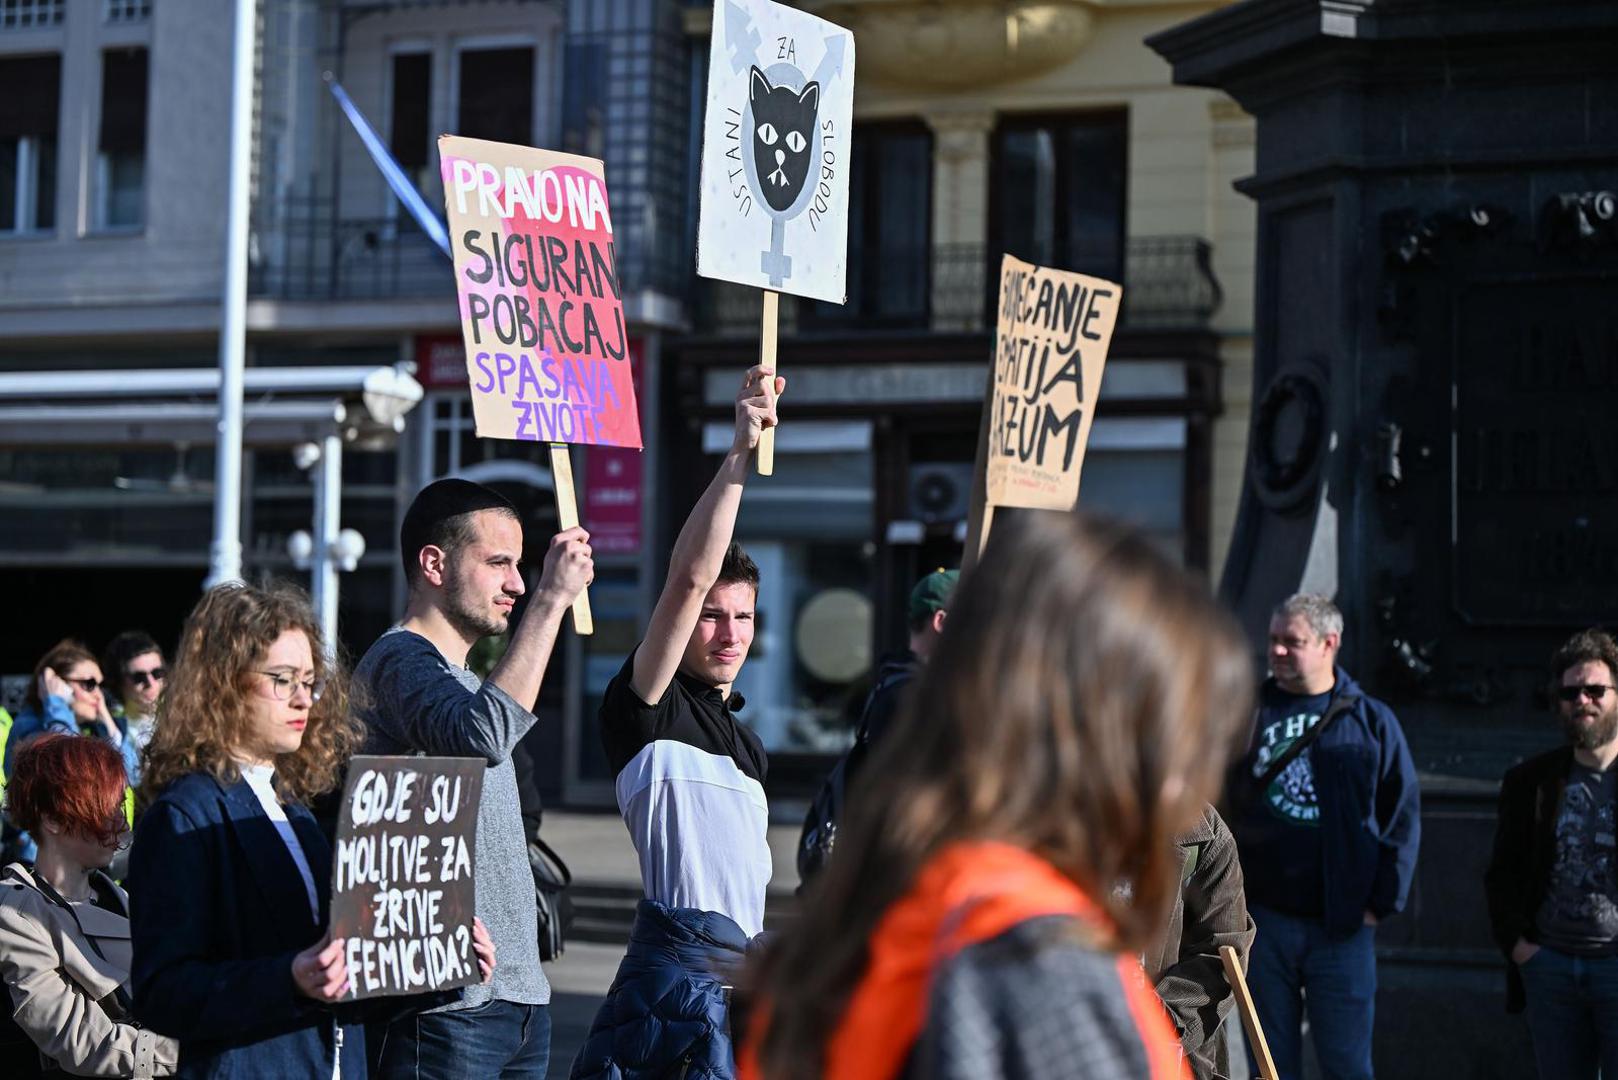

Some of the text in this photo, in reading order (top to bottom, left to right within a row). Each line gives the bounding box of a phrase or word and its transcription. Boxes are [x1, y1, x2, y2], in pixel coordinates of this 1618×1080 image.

[724, 36, 836, 232] USTANI ZA SLOBODU
[453, 160, 613, 234] PRAVO NA
[463, 229, 621, 300] SIGURAN
[468, 289, 626, 361] POBAČAJ
[475, 347, 622, 410] SPAŠAVA
[512, 392, 614, 446] ŽIVOTE
[991, 390, 1083, 473] AZUM
[352, 769, 462, 826] GDJE SU
[336, 831, 472, 893] MOLITVE ZA
[373, 879, 445, 938] ŽRTVE
[346, 925, 472, 999] FEMICIDA?
